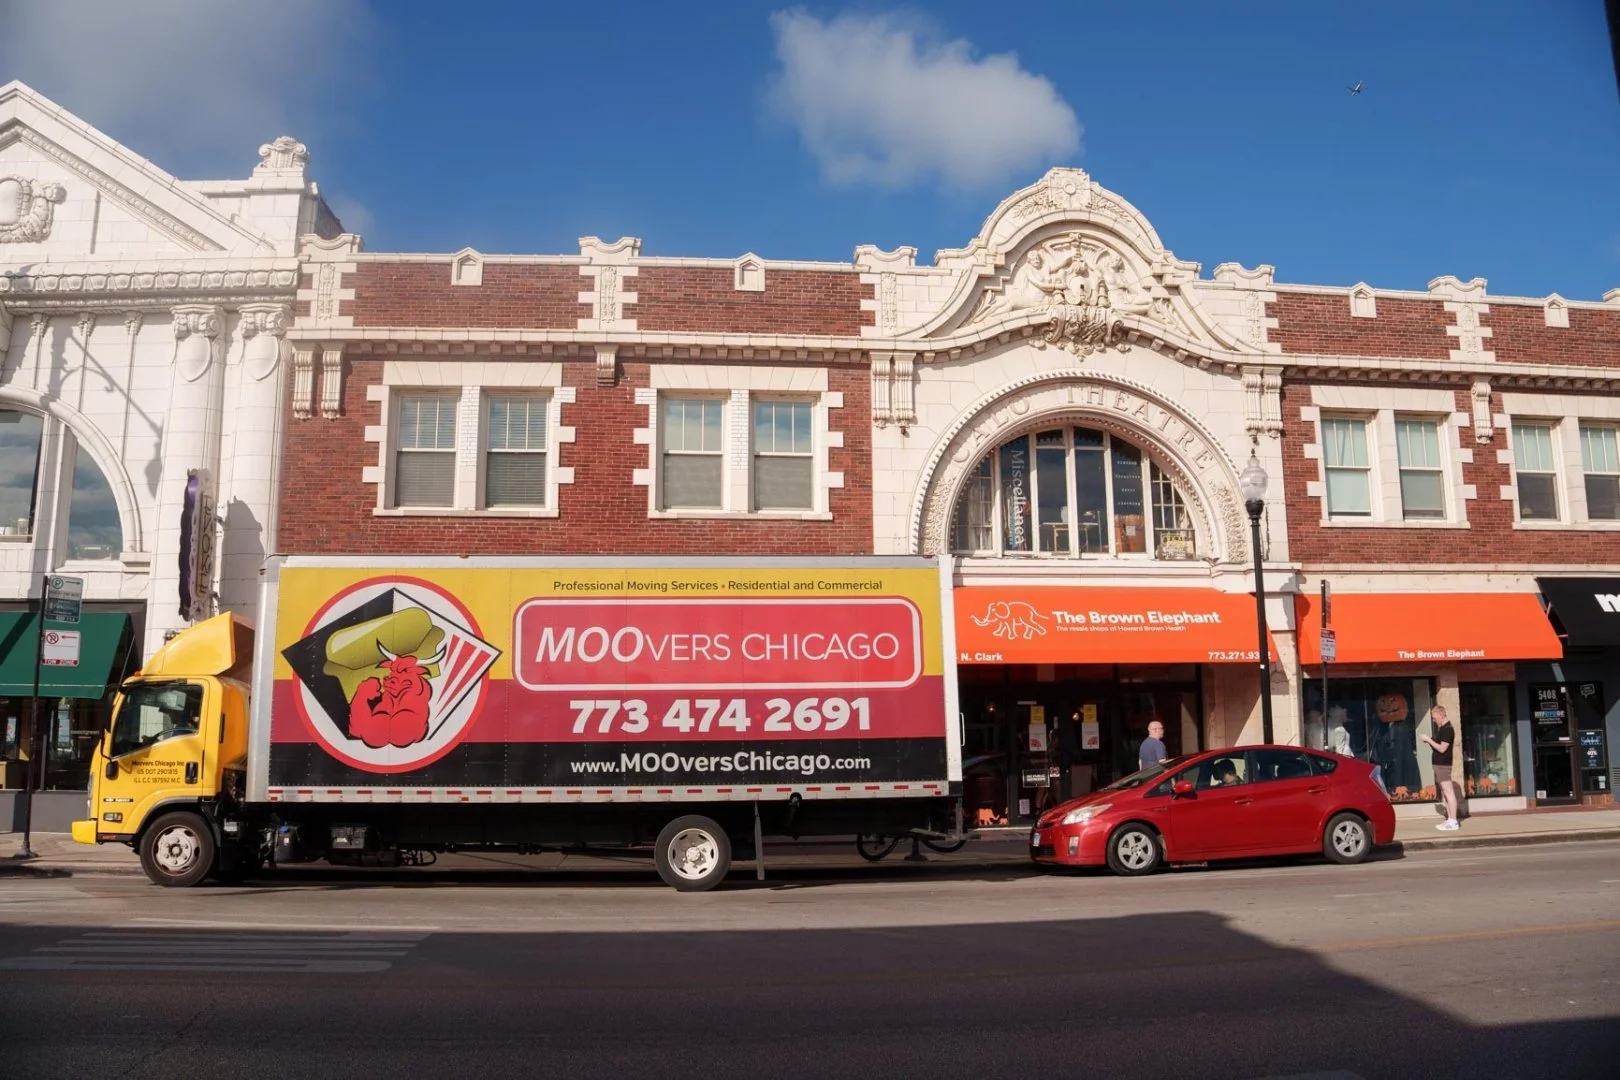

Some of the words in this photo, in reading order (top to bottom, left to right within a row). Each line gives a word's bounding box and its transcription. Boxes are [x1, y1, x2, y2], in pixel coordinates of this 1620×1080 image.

[952, 398, 1030, 463] CALO
[1066, 385, 1214, 470] THEATRE
[1010, 449, 1027, 545] Miscellanea
[553, 580, 624, 591] Professional
[627, 580, 668, 592] Moving
[671, 580, 719, 590] Services
[728, 579, 790, 590] Residential
[793, 579, 814, 590] and
[817, 579, 883, 590] Commercial
[1052, 611, 1086, 624] The
[1089, 611, 1145, 624] Brown
[1147, 611, 1222, 626] Elephant
[741, 632, 899, 660] CHICAGO
[960, 652, 972, 661] N.
[975, 652, 1003, 661] Clark
[1398, 650, 1415, 658] The
[1417, 650, 1445, 658] Brown
[1447, 649, 1485, 659] Elephant
[1538, 689, 1557, 700] 5408
[1580, 736, 1602, 745] SALE
[570, 751, 871, 776] www.MOOversChicago.com
